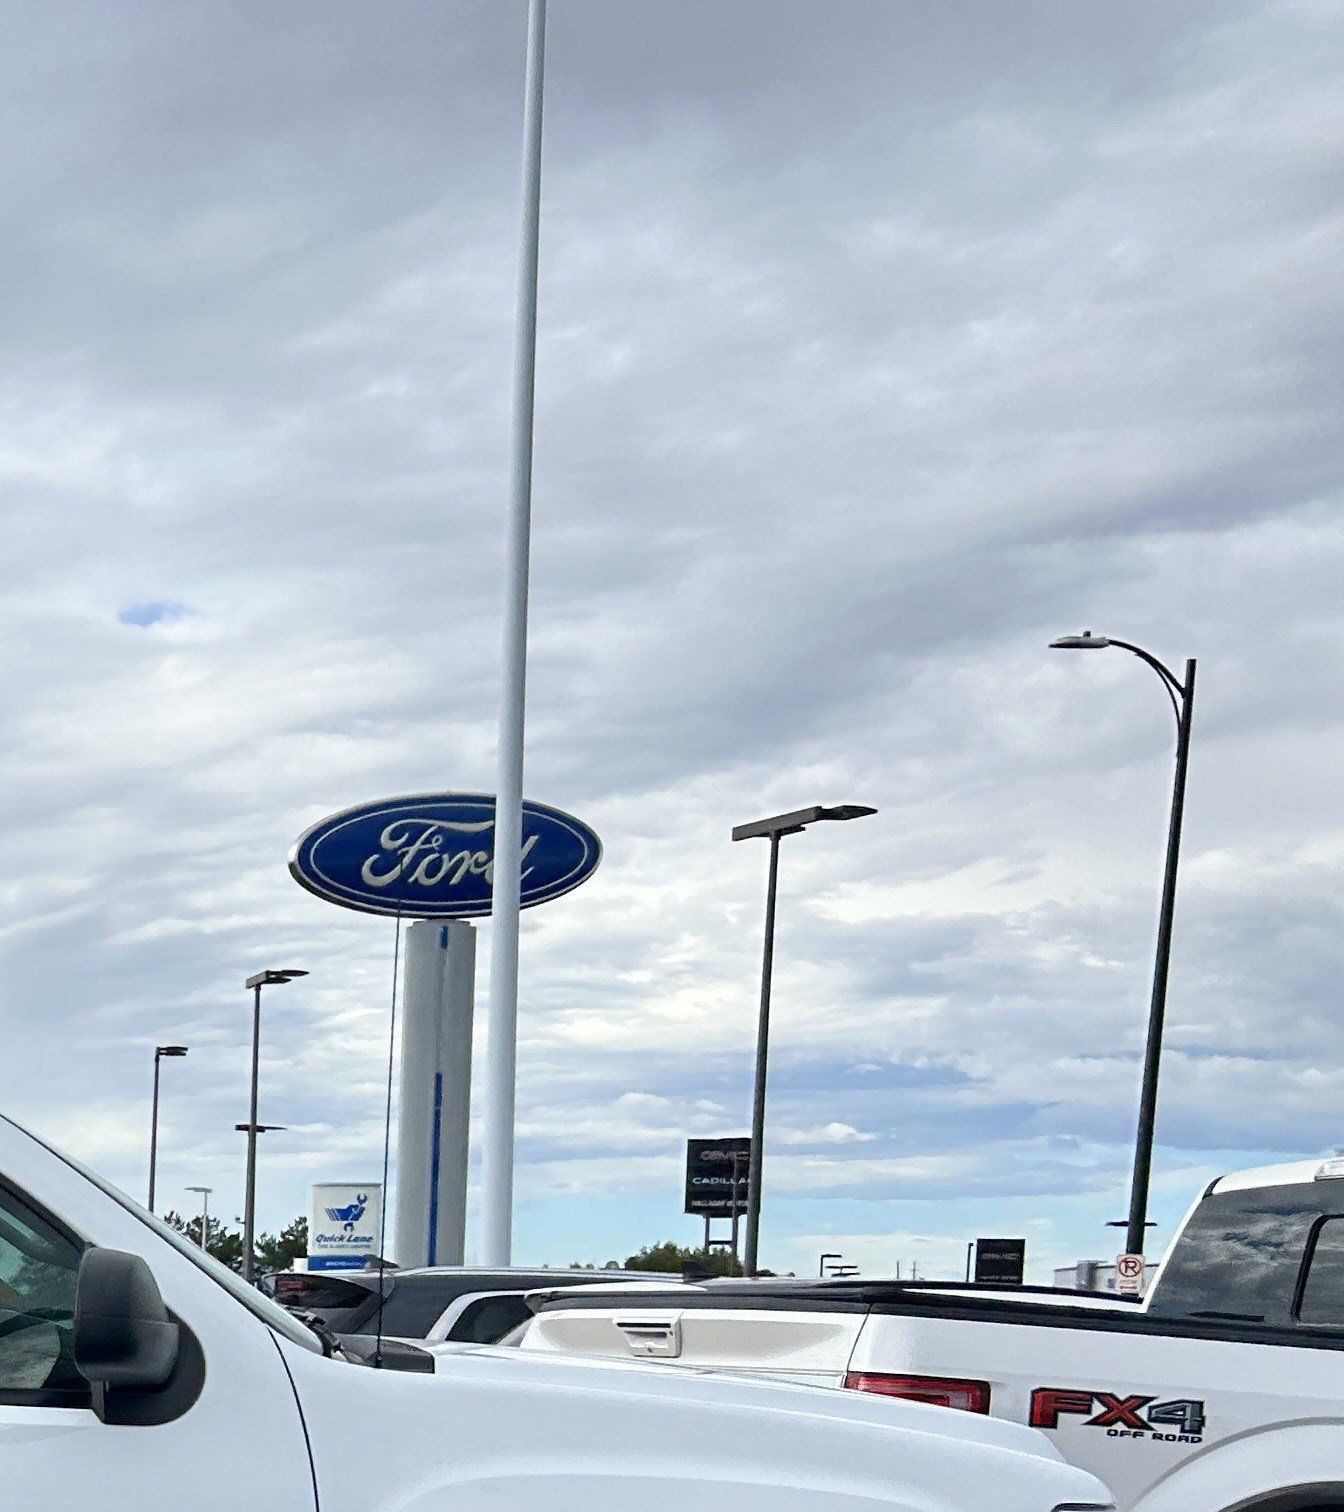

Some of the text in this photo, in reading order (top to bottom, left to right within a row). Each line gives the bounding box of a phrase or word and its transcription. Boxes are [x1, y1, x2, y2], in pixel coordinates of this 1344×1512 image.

[692, 1177, 750, 1185] CADILLA
[315, 1233, 374, 1243] Quick Lane
[1028, 1386, 1207, 1434] FX4
[1106, 1428, 1204, 1444] OFF ROAD
